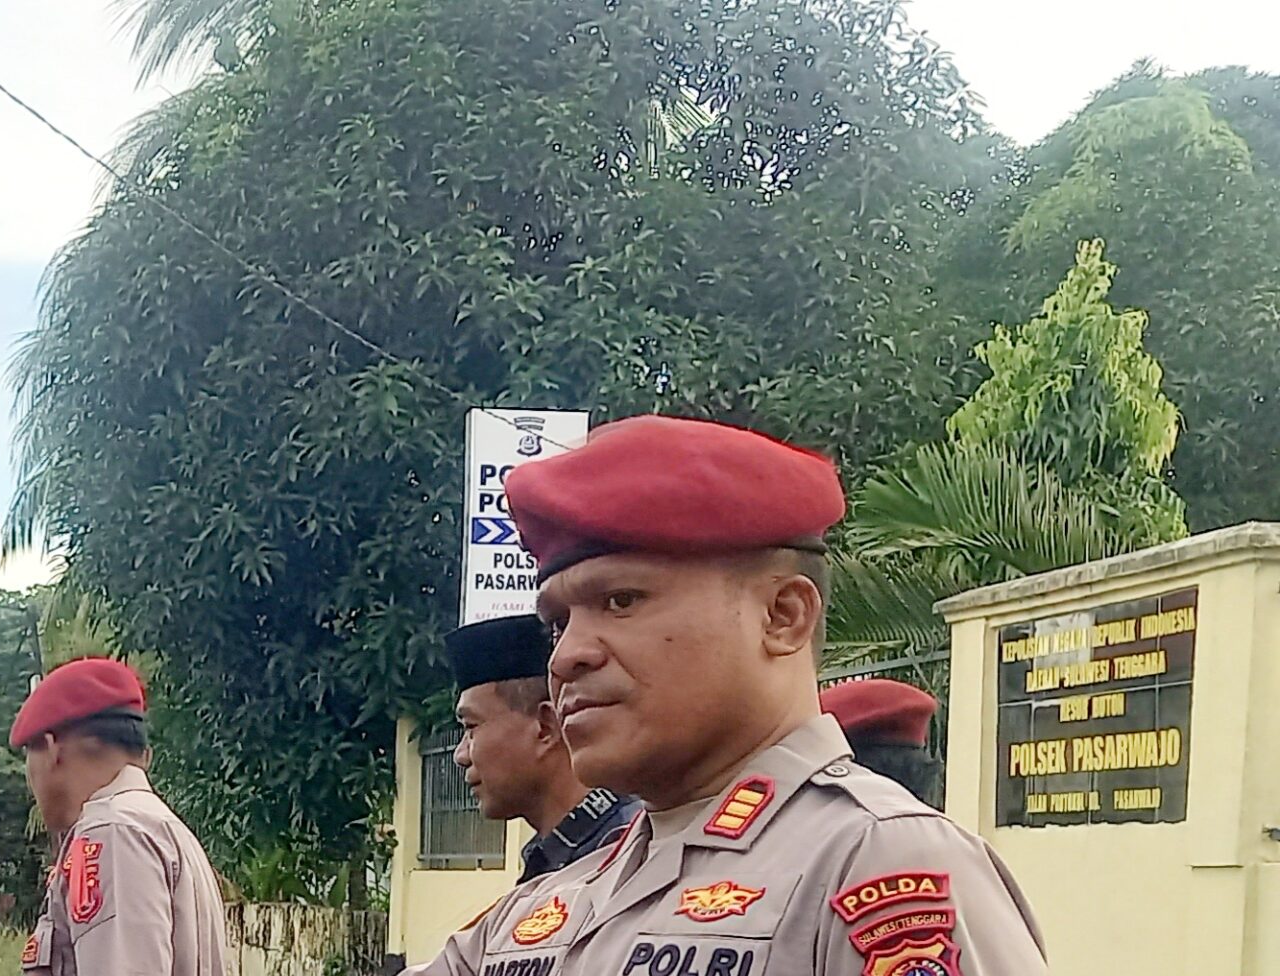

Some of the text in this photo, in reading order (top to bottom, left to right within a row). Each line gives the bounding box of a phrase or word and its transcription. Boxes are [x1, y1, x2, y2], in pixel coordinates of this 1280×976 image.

[493, 553, 538, 569] POLS
[1140, 606, 1196, 640] INDONESIA
[1063, 659, 1110, 688] SULAWESI
[1113, 650, 1167, 680] TENGGARA
[1009, 728, 1181, 777] POLSEK PASARWAJO
[842, 878, 937, 912] POLDA
[858, 913, 948, 945] SULAWESI TENGGARA
